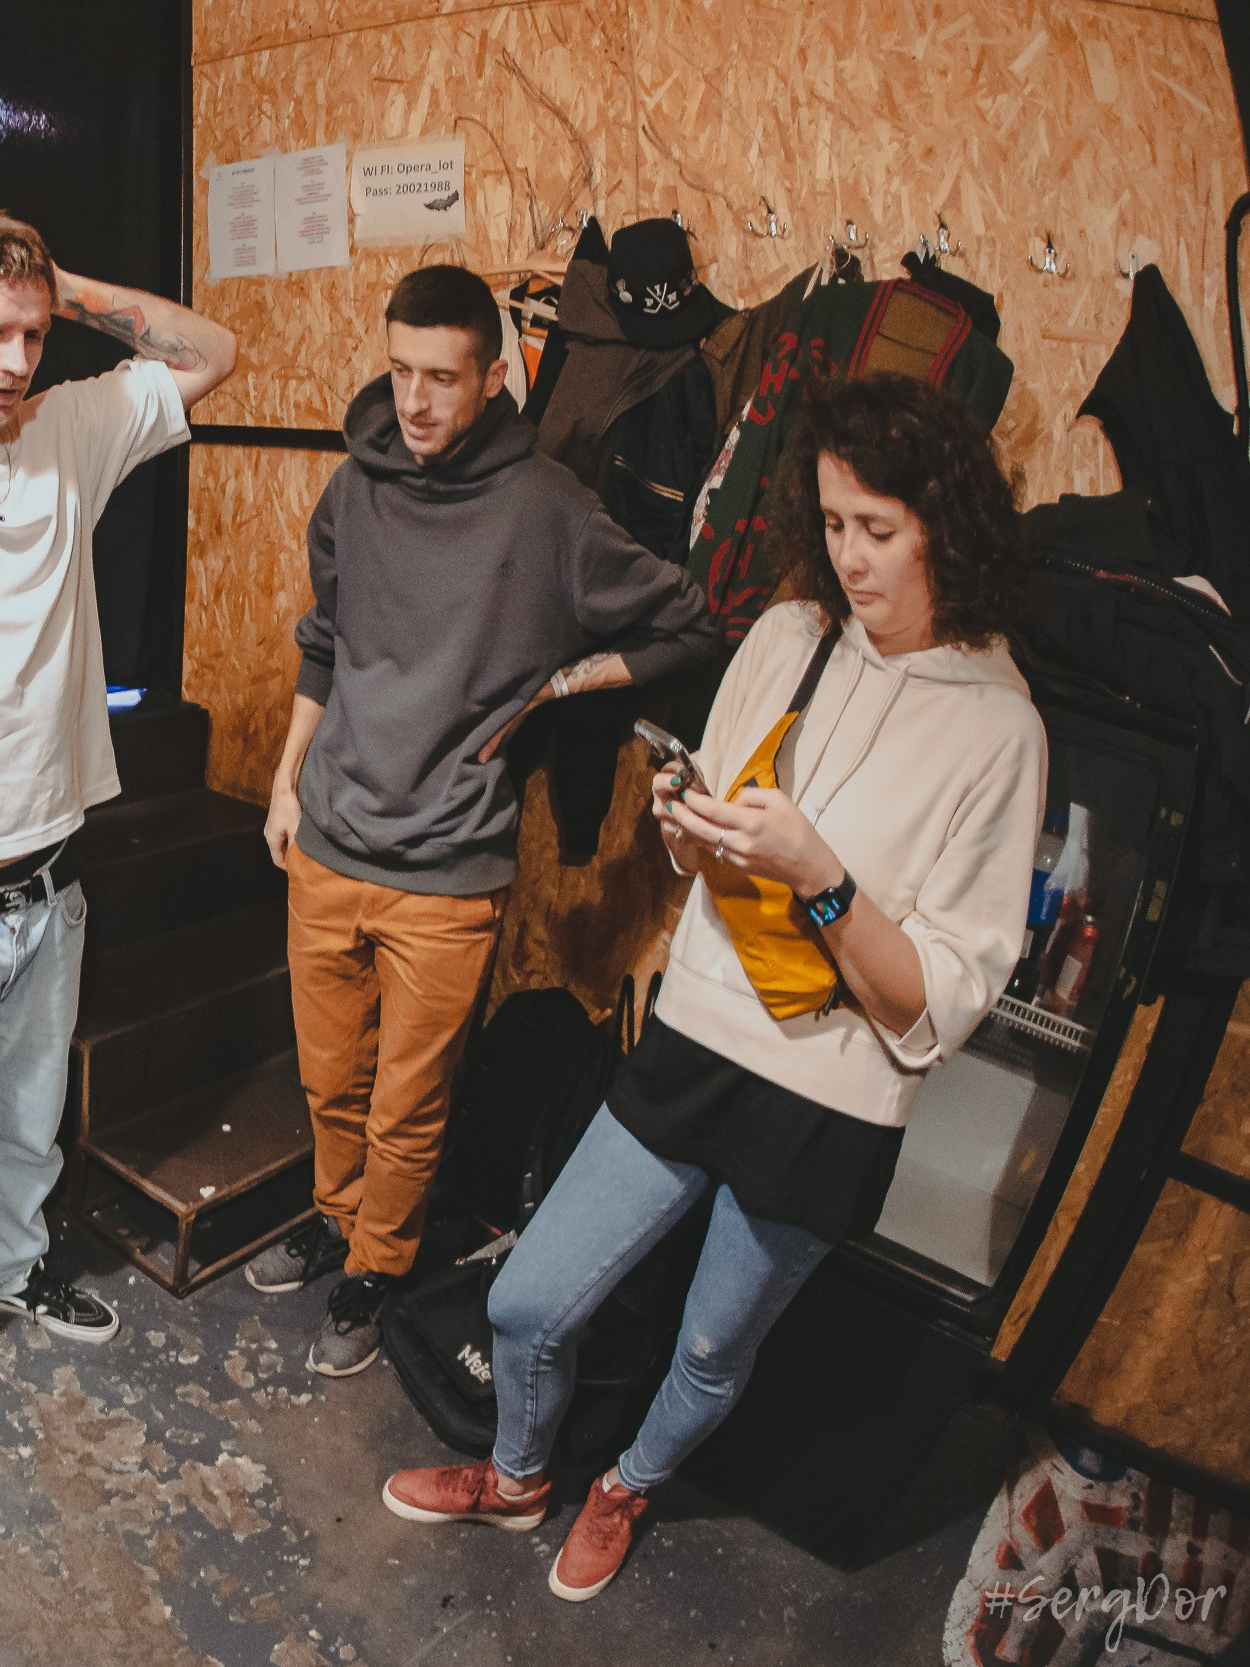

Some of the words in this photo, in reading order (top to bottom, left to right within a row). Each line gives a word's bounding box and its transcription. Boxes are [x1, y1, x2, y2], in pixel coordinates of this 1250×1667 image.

[362, 165, 379, 177] WI
[365, 185, 392, 197] Pass:
[395, 180, 451, 195] 20021988
